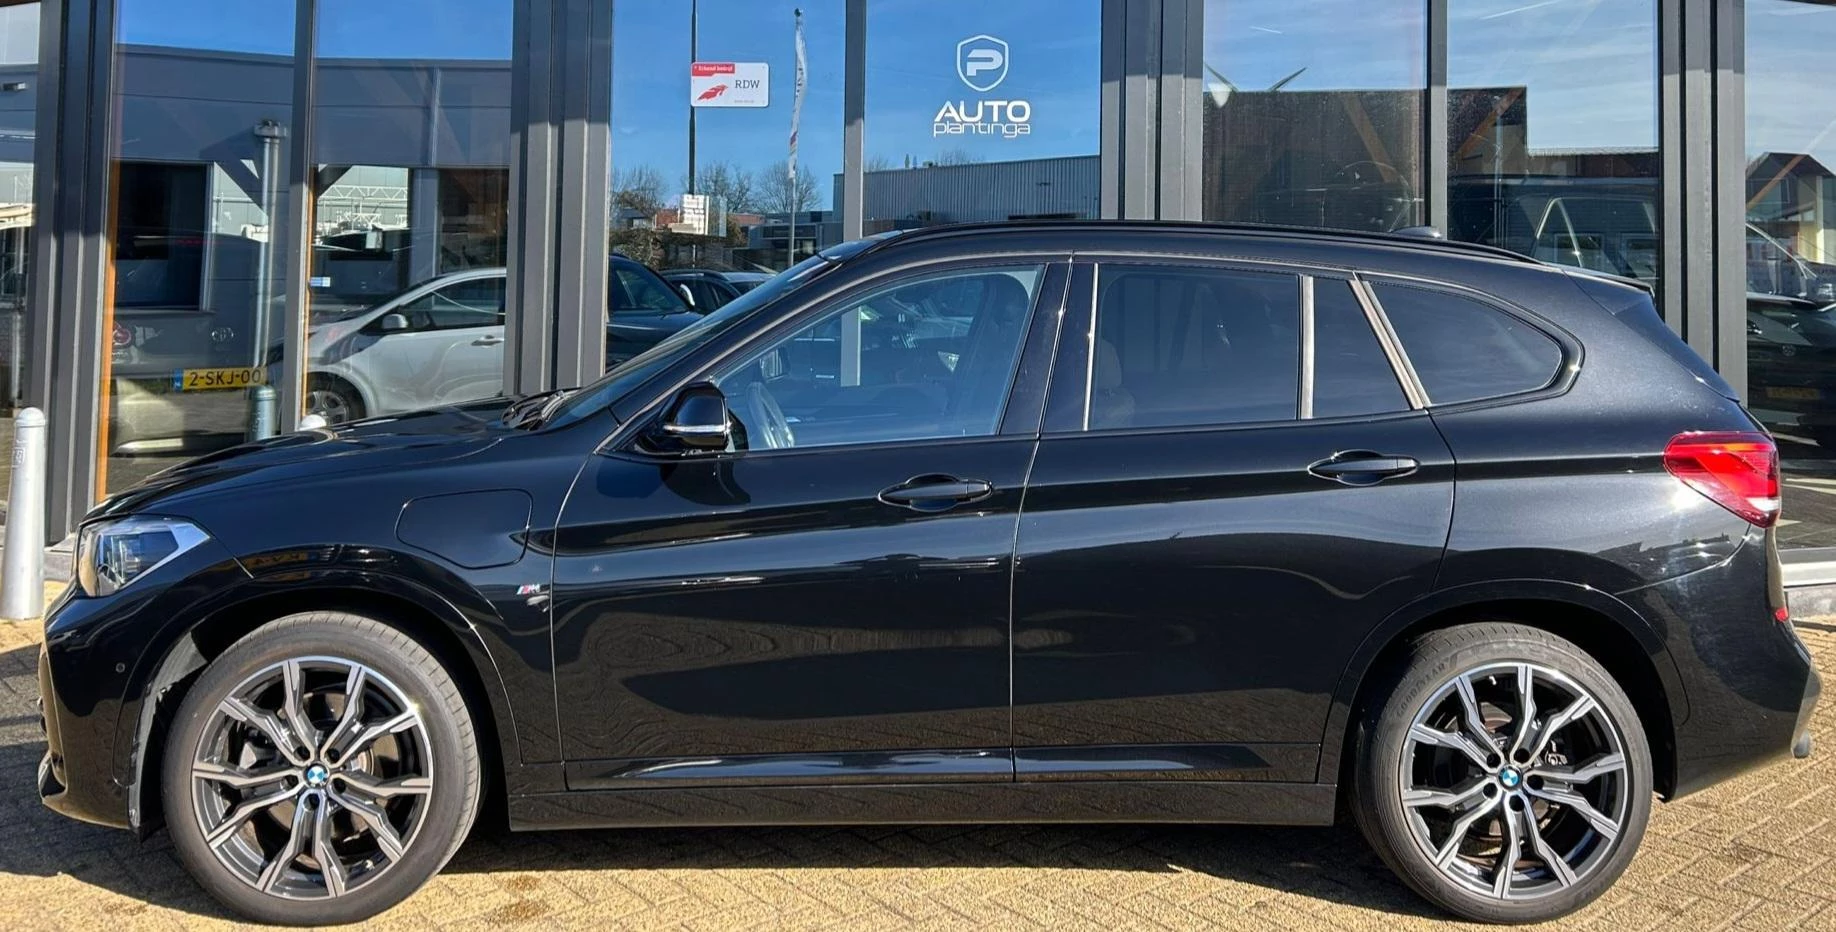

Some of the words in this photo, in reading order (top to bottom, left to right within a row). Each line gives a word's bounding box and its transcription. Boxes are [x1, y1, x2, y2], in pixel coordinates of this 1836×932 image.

[966, 48, 1003, 76] P
[734, 80, 760, 89] RDW
[934, 100, 1031, 122] AUTO
[933, 120, 1031, 138] plantinga
[190, 370, 261, 386] 2-SKJ-00
